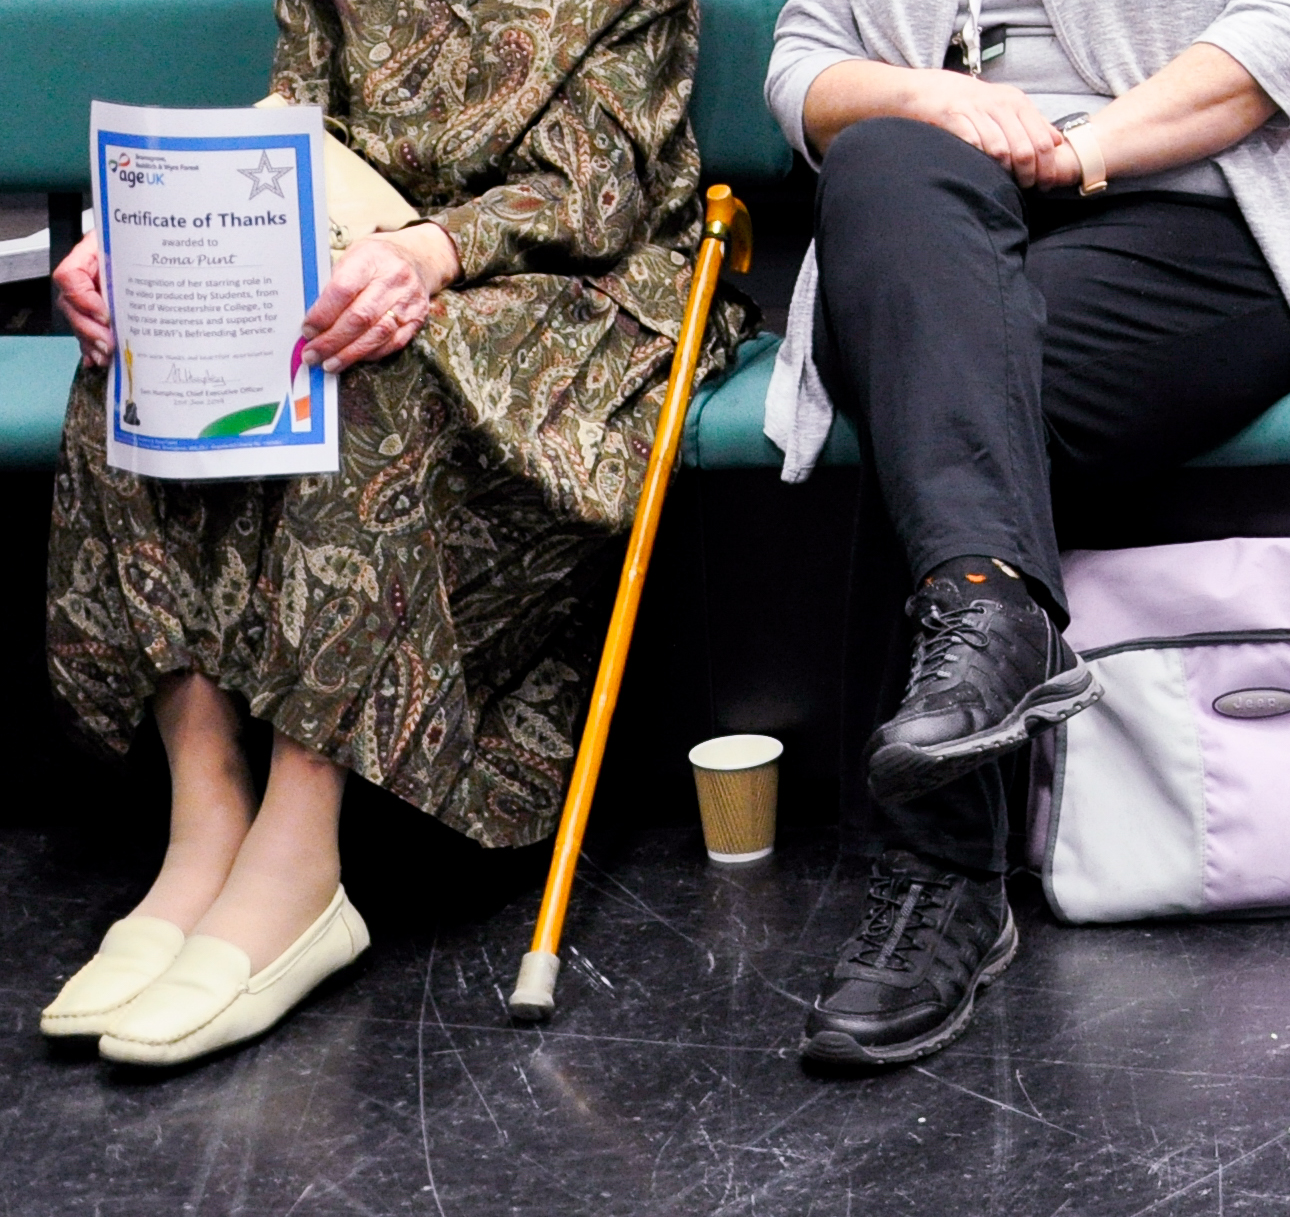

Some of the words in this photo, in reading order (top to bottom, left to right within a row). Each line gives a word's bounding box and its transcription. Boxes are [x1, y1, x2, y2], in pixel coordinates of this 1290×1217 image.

[119, 169, 144, 188] age
[146, 172, 164, 185] UK
[114, 208, 187, 228] Certificate
[192, 212, 212, 228] of
[218, 210, 287, 228] Thanks
[162, 237, 204, 247] awarded
[207, 237, 218, 247] to
[151, 253, 193, 266] Roma
[197, 253, 237, 266] Punt
[177, 279, 186, 287] of
[187, 279, 202, 287] her
[205, 279, 240, 288] starring
[243, 277, 260, 285] role
[263, 276, 272, 284] in
[155, 291, 194, 300] produced
[196, 292, 208, 301] by
[210, 291, 253, 300] Students,
[256, 289, 278, 297] from
[157, 304, 221, 312] Worcestershire
[223, 303, 260, 312] College,
[160, 317, 204, 325] awareness
[206, 317, 223, 325] and
[226, 315, 261, 324] support
[264, 313, 277, 321] for
[185, 329, 237, 338] Befriending
